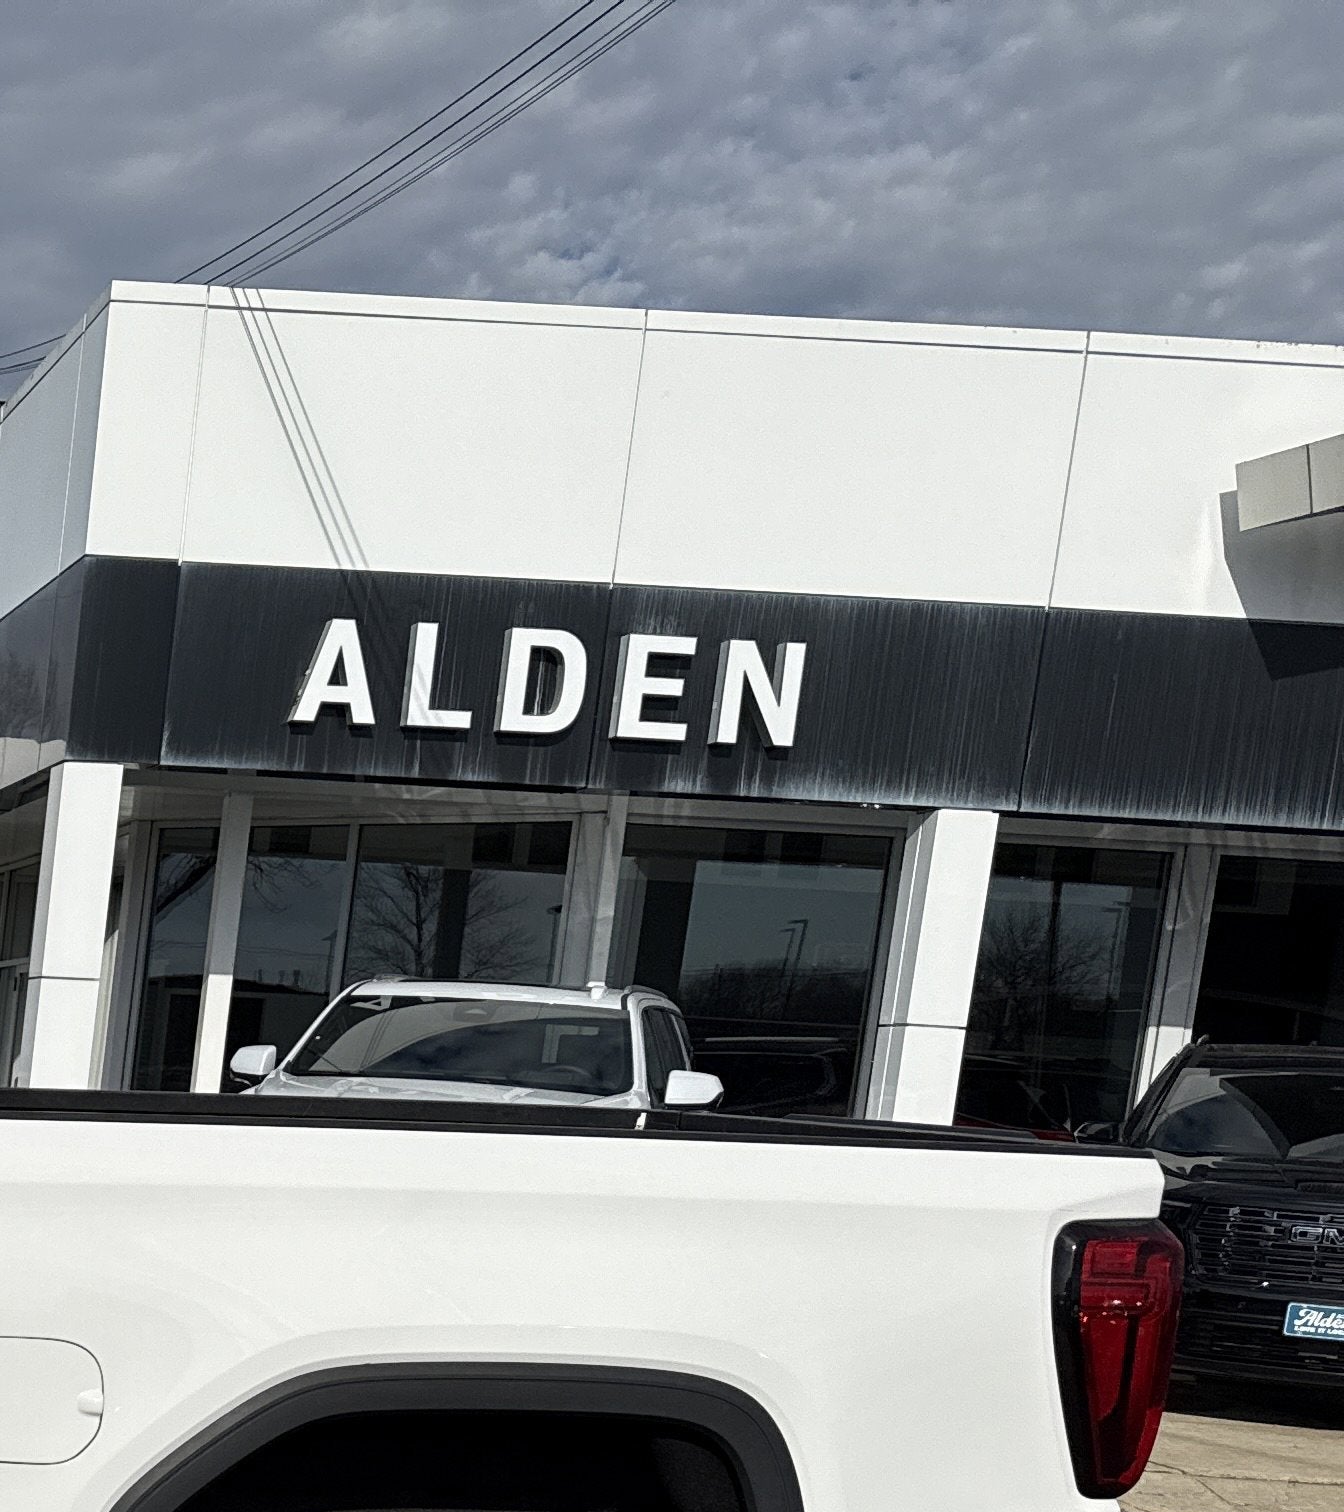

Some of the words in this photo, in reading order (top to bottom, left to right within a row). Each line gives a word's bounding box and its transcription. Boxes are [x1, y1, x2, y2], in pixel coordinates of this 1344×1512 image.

[286, 617, 808, 749] ALDEN
[1291, 1226, 1344, 1244] GM
[1294, 1308, 1344, 1329] Alde
